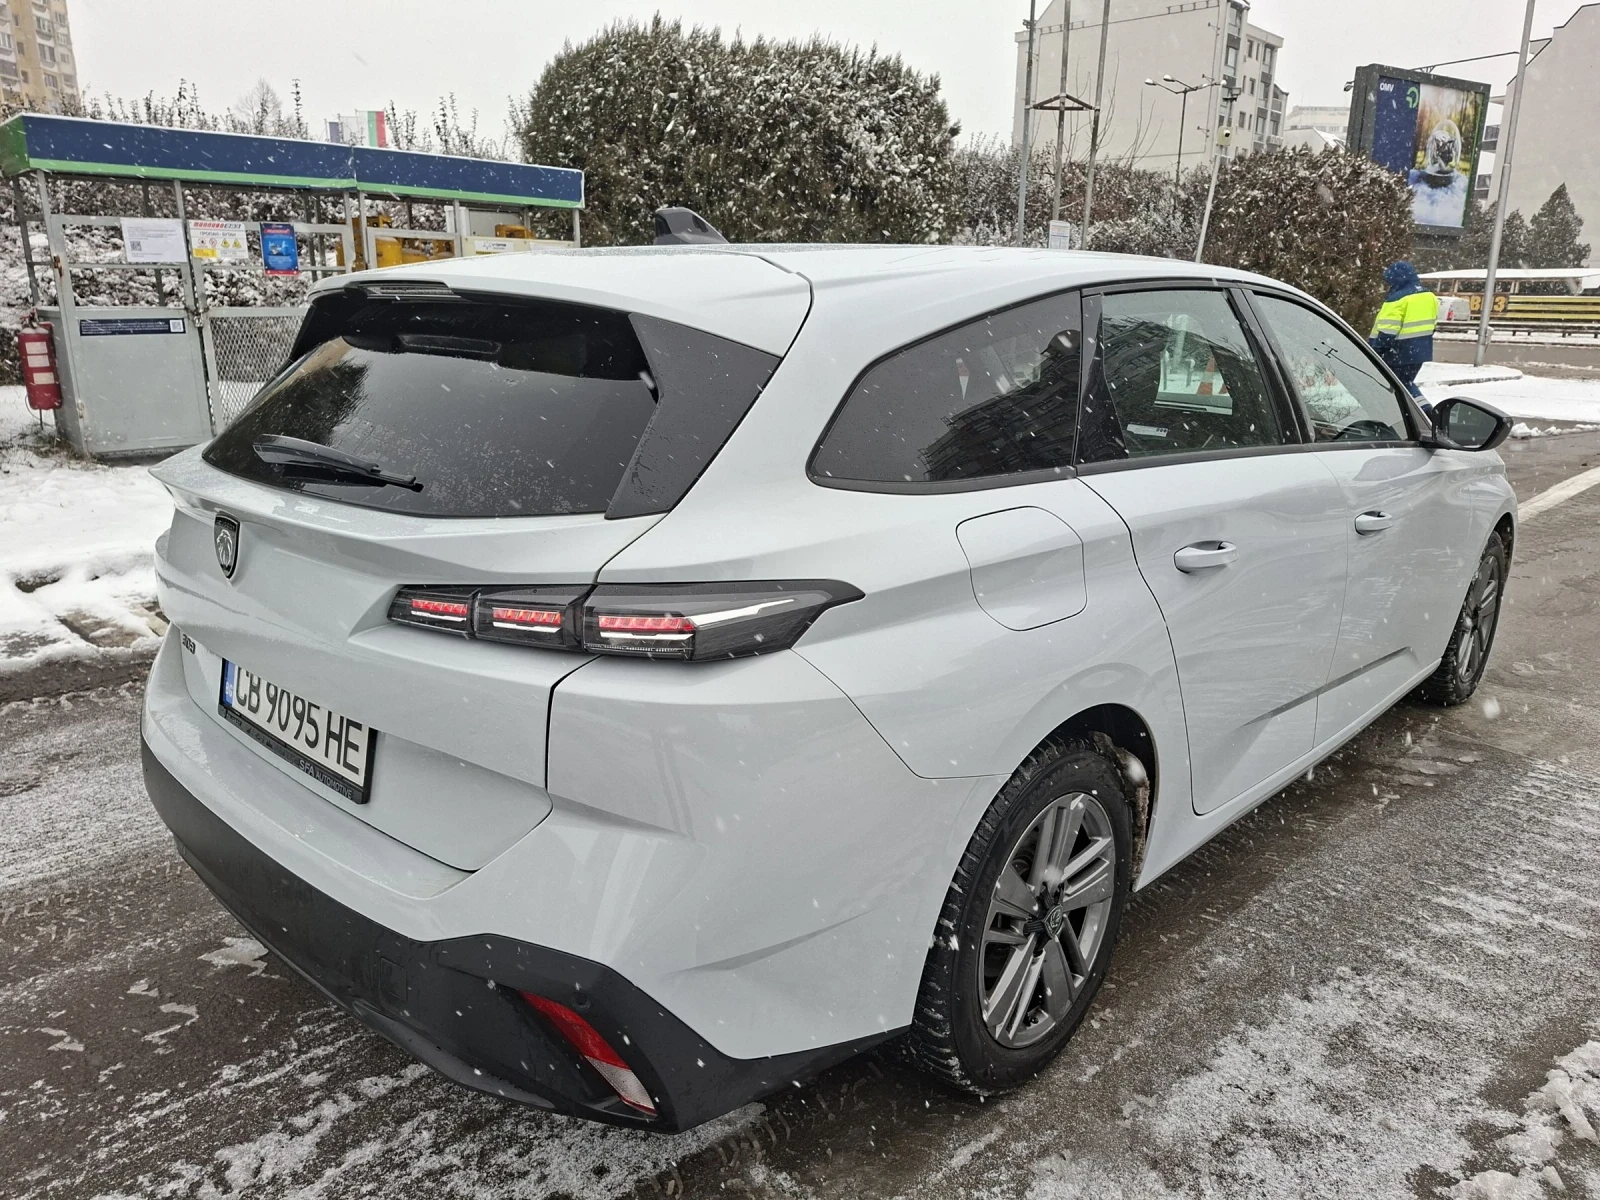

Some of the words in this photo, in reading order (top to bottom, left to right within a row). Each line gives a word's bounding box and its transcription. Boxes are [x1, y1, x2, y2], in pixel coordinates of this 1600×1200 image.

[1379, 82, 1394, 92] OMV
[225, 682, 233, 697] BG
[236, 666, 261, 714] CB
[266, 682, 320, 749] 9095
[324, 710, 363, 775] HE
[299, 759, 315, 776] SFA
[315, 771, 353, 800] AUTOMOTIVE
